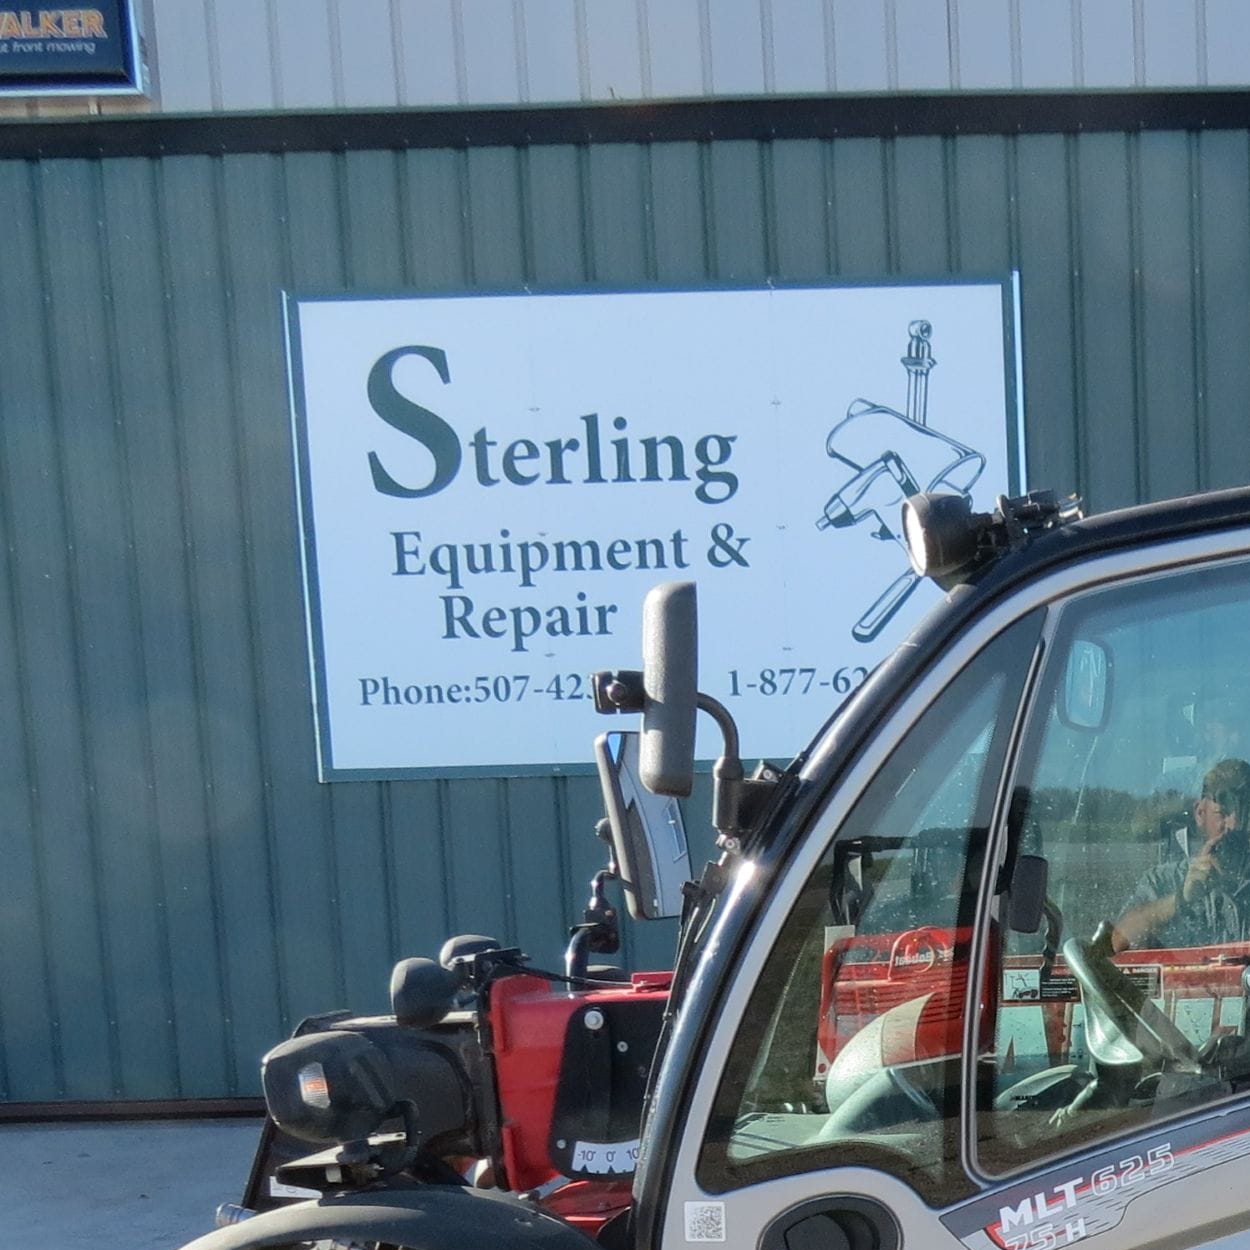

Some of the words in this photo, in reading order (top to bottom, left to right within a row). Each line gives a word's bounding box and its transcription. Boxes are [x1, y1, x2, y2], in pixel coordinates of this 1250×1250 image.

[0, 9, 108, 39] ALKER
[13, 41, 42, 52] front
[46, 41, 96, 55] mowing
[367, 344, 739, 505] Sterling
[390, 528, 691, 589] Equipment
[707, 522, 751, 568] &
[439, 592, 618, 652] Repair
[359, 673, 593, 706] Phone:507-42
[999, 1176, 1083, 1234] MLT
[1091, 1142, 1175, 1197] 625
[1064, 1217, 1087, 1242] H
